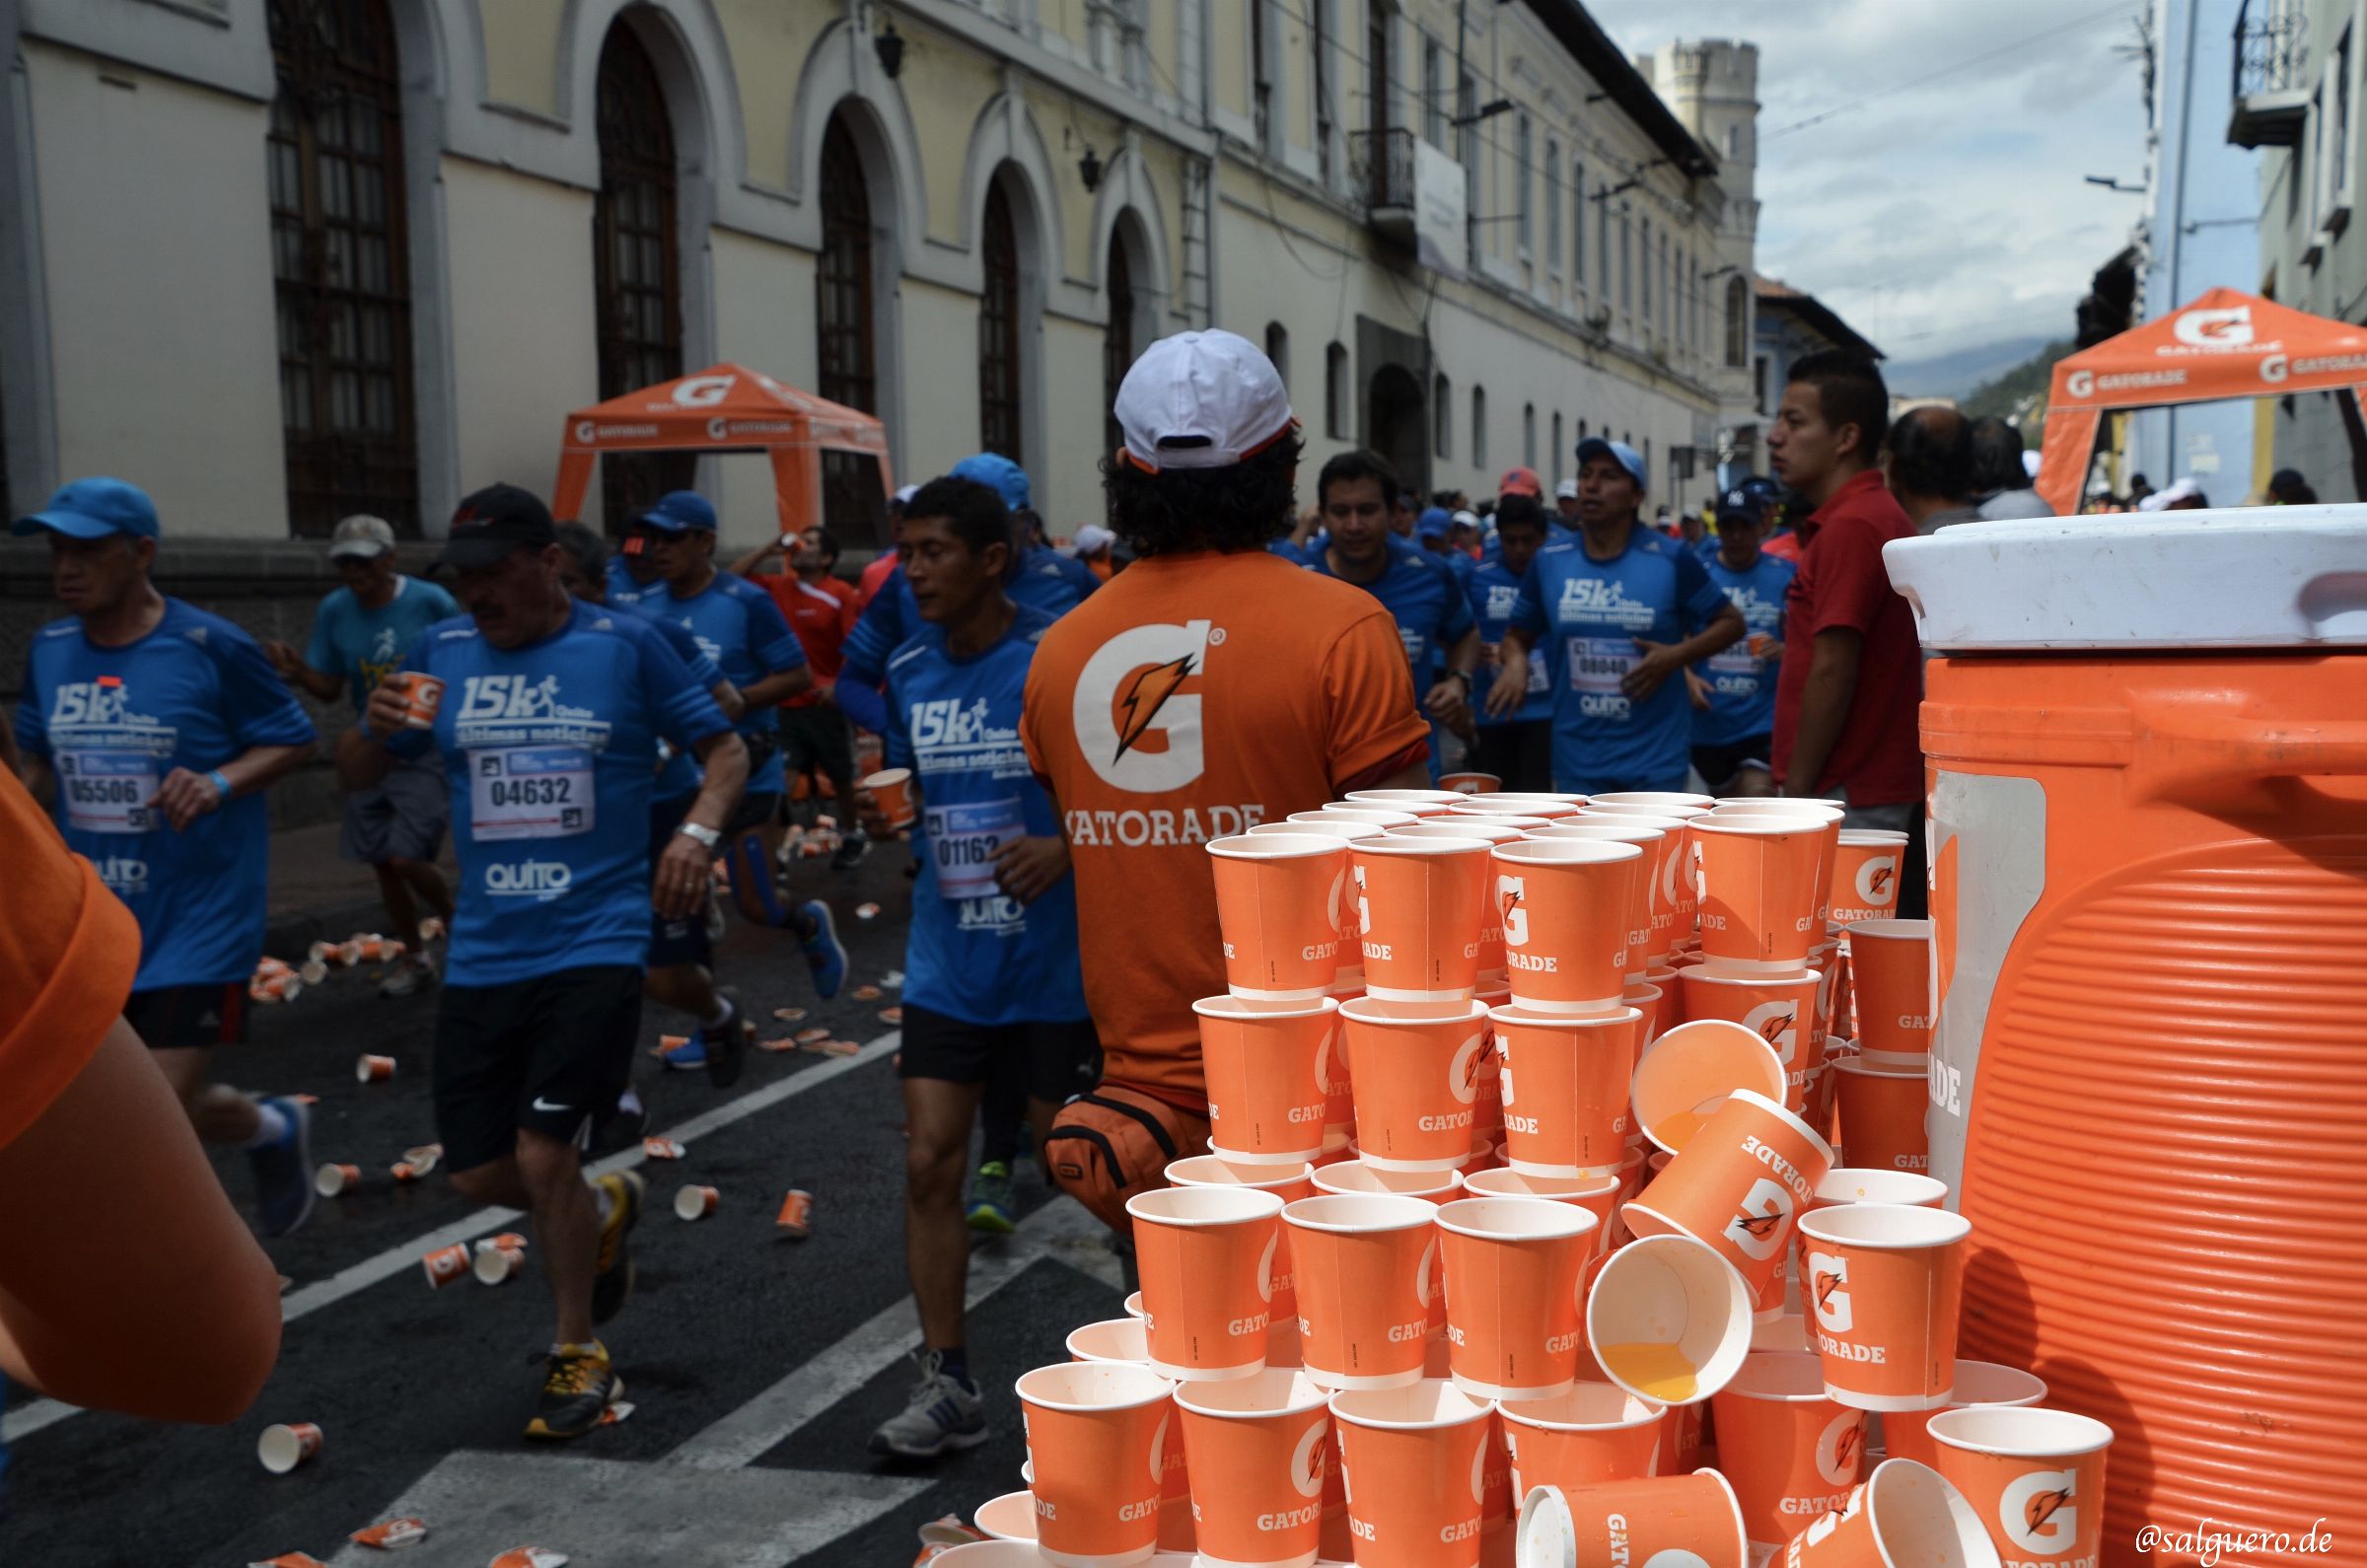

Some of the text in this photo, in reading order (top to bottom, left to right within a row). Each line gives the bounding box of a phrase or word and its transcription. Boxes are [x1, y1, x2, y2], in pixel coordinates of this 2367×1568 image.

[2098, 369, 2188, 391] GATORADE
[491, 778, 572, 807] 04632
[1256, 1501, 1323, 1532] GATOR
